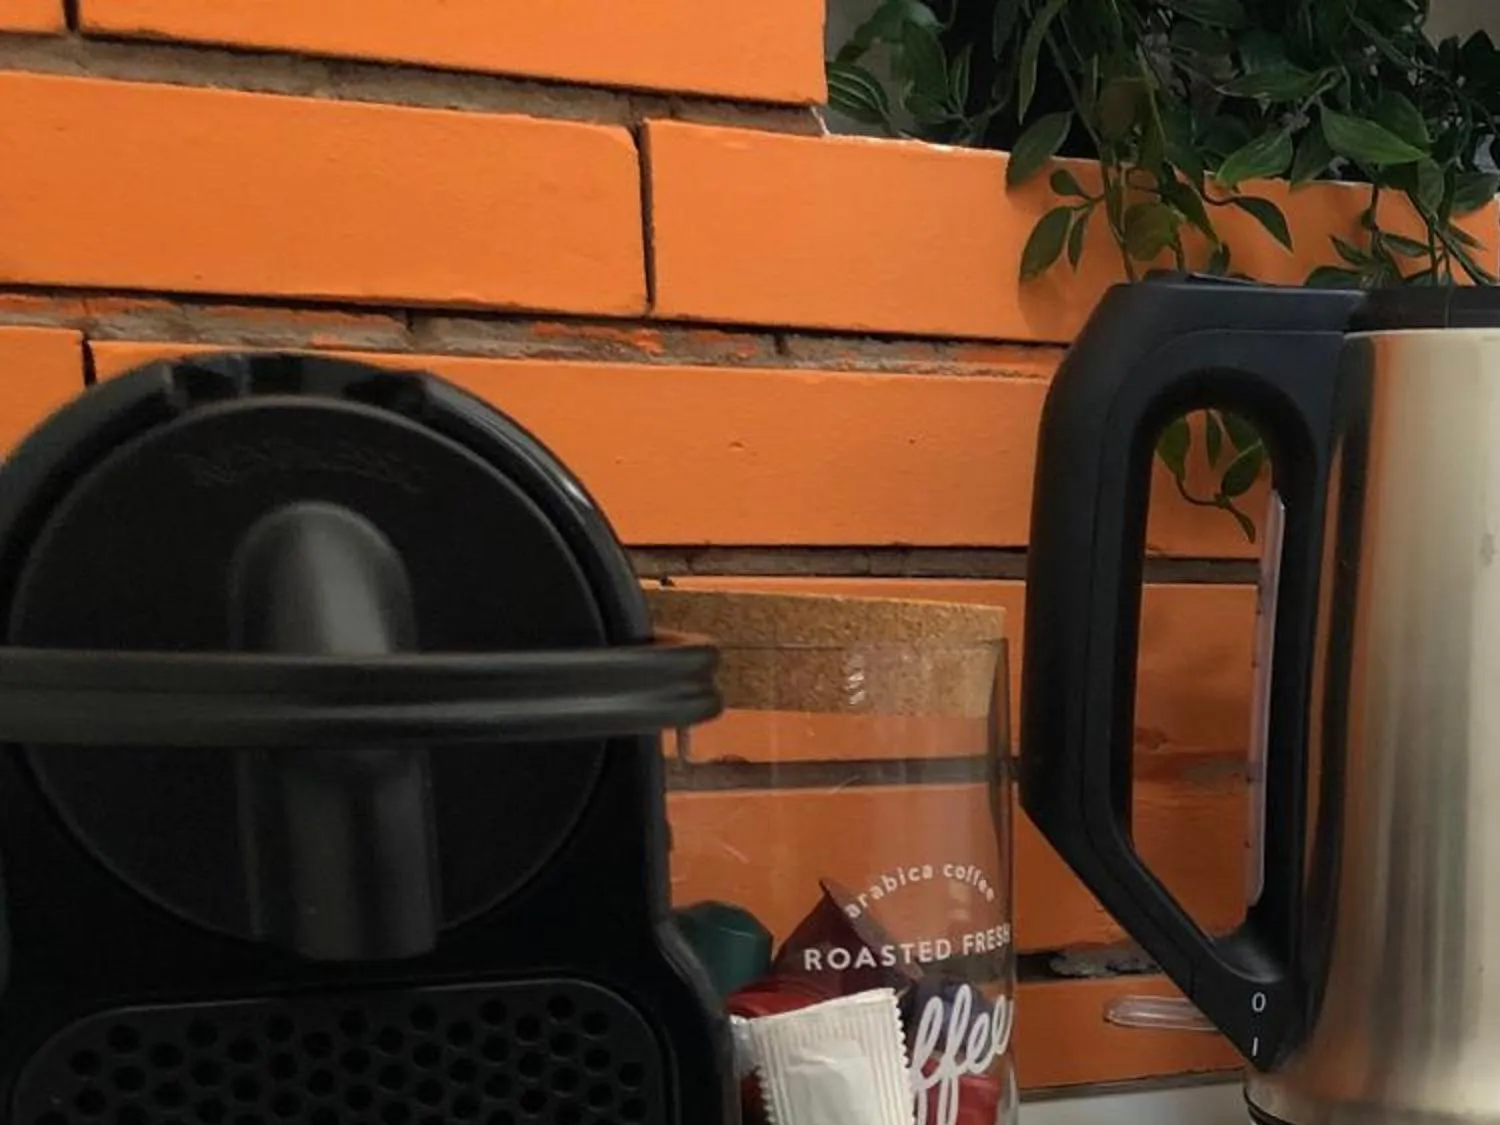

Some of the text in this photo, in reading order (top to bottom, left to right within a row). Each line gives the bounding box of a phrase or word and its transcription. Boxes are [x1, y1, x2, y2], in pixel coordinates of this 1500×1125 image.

[844, 863, 995, 919] arabica coffee
[803, 939, 951, 971] ROASTED
